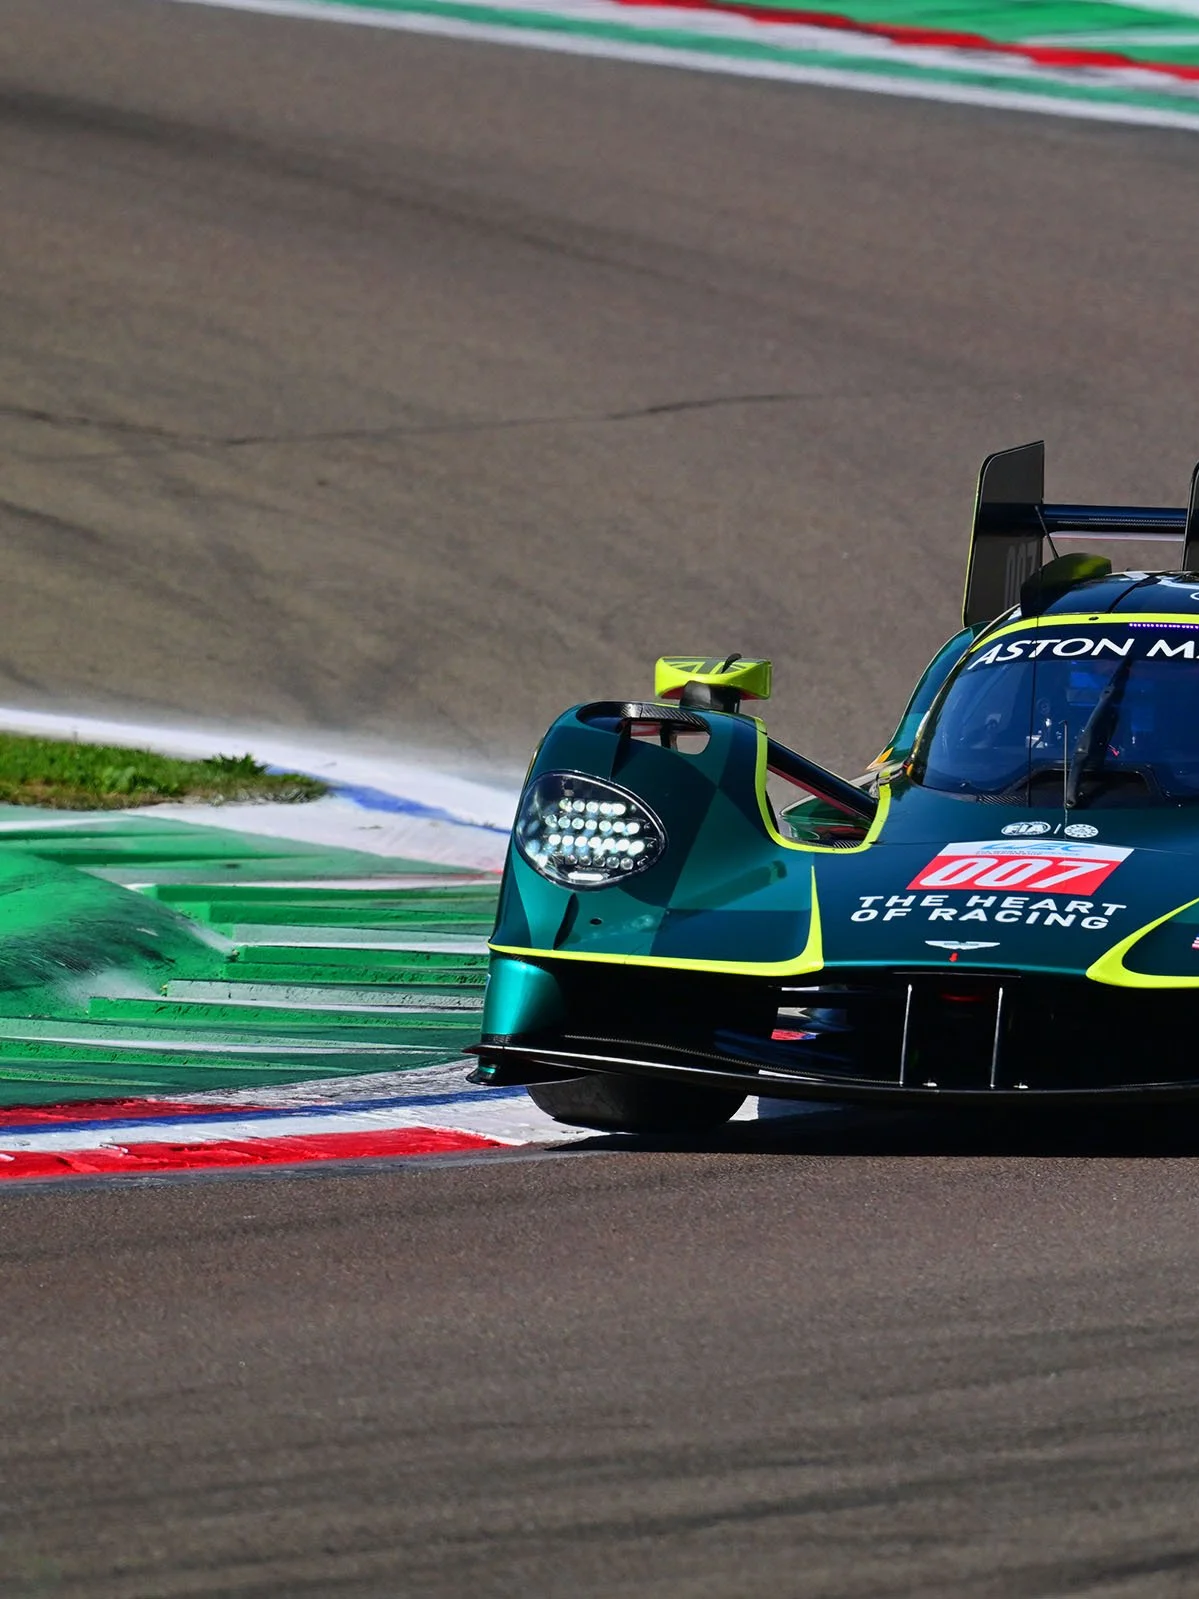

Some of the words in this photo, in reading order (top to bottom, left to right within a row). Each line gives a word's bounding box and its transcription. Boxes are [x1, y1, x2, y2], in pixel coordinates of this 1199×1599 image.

[968, 638, 1135, 671] ASTON
[1002, 823, 1045, 835] FIA
[918, 857, 1111, 889] 007
[859, 895, 949, 909] THE
[966, 895, 1128, 917] HEART
[850, 908, 913, 923] OF
[927, 908, 1110, 930] RACING
